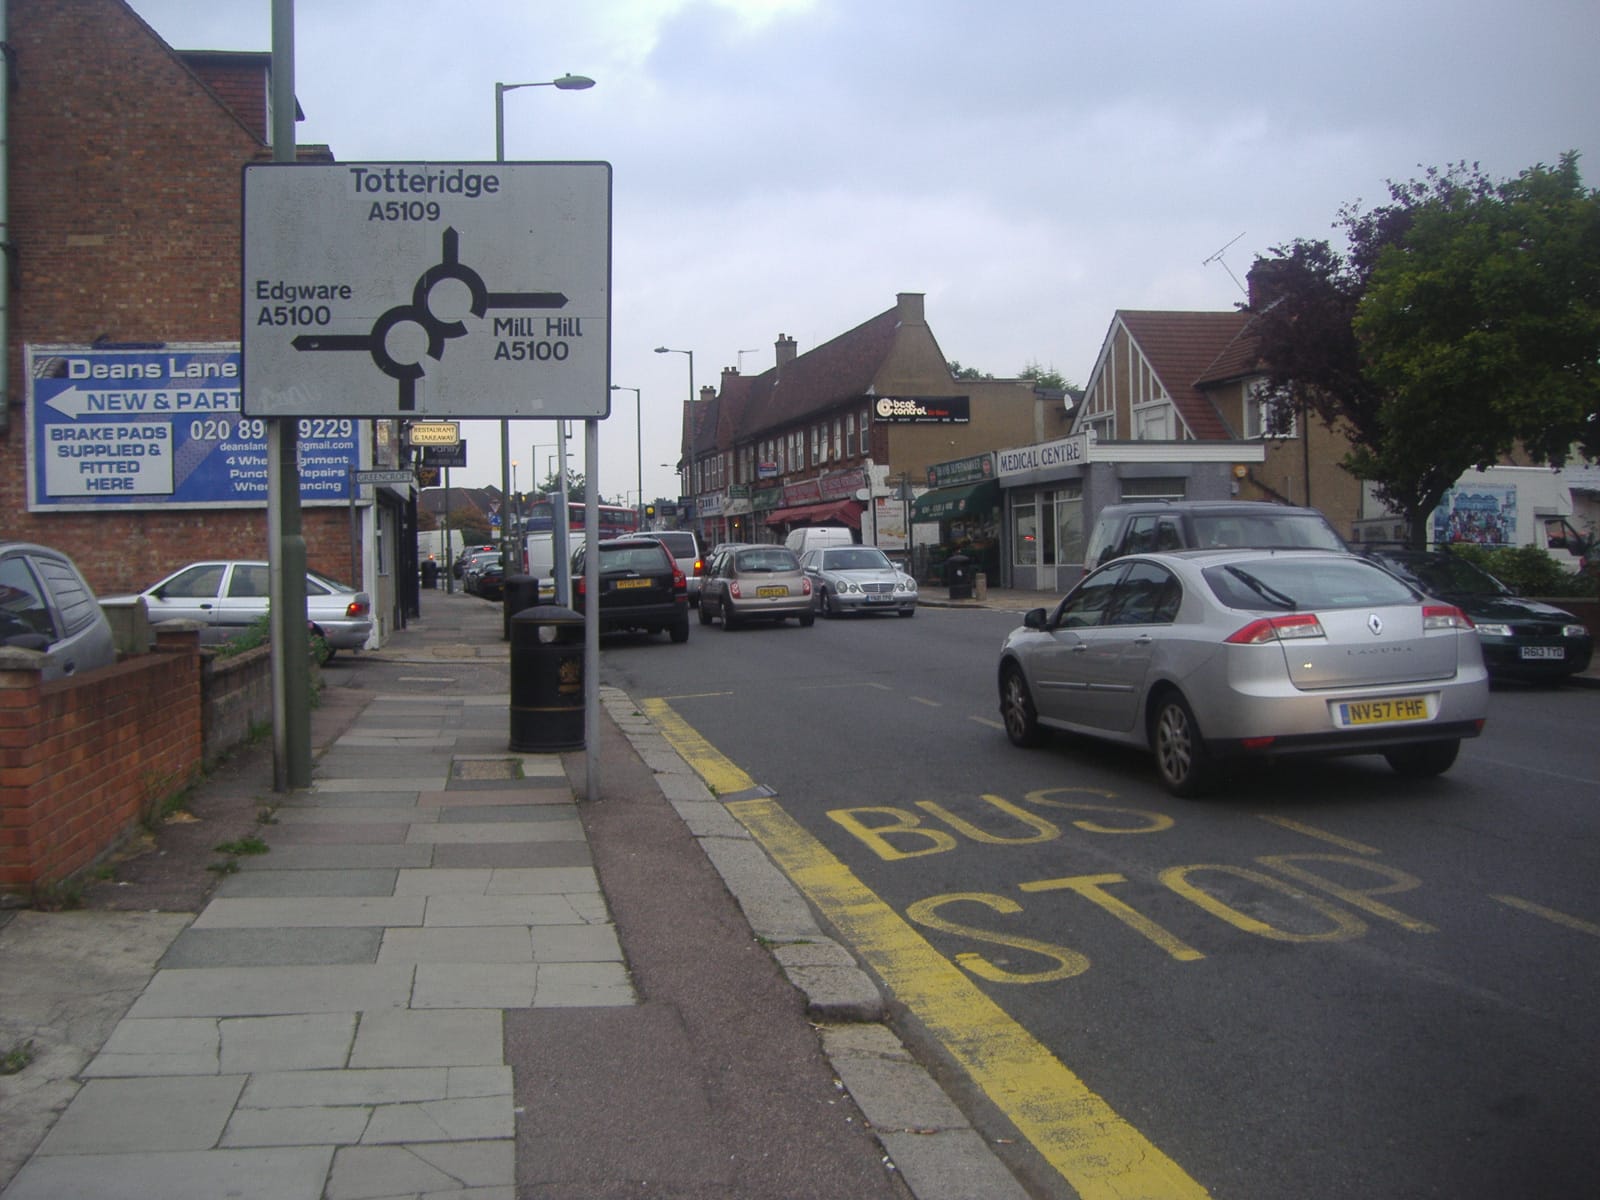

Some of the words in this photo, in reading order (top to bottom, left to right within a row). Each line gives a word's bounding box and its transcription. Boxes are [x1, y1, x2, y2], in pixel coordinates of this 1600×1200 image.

[350, 167, 500, 198] Totteridge
[368, 201, 441, 221] A5109
[256, 280, 352, 303] Edgware
[257, 306, 331, 326] A5100
[494, 318, 534, 337] Mill
[546, 318, 583, 337] Hill
[494, 341, 569, 361] A5100
[68, 359, 162, 379] Deans
[168, 358, 238, 378] Lane
[87, 393, 147, 411] NEW
[153, 393, 170, 410] &
[893, 406, 927, 416] control
[51, 427, 114, 441] BRAKE
[117, 426, 167, 440] PADS
[190, 420, 231, 440] 020
[299, 419, 352, 438] 9229
[413, 425, 455, 433] RESTAURANT
[422, 433, 454, 441] TAKEAWAY
[57, 444, 145, 458] SUPPLIED
[148, 443, 162, 456] &
[1000, 453, 1038, 472] MEDICAL
[1041, 442, 1081, 466] CENTRE
[79, 461, 140, 474] FITTED
[226, 456, 235, 465] 4
[86, 478, 135, 491] HERE
[357, 471, 412, 482] GREENCROFT
[1350, 703, 1391, 720] NV57
[1395, 700, 1423, 717] FHF
[826, 787, 1176, 861] BUS
[905, 853, 1440, 984] STOP
